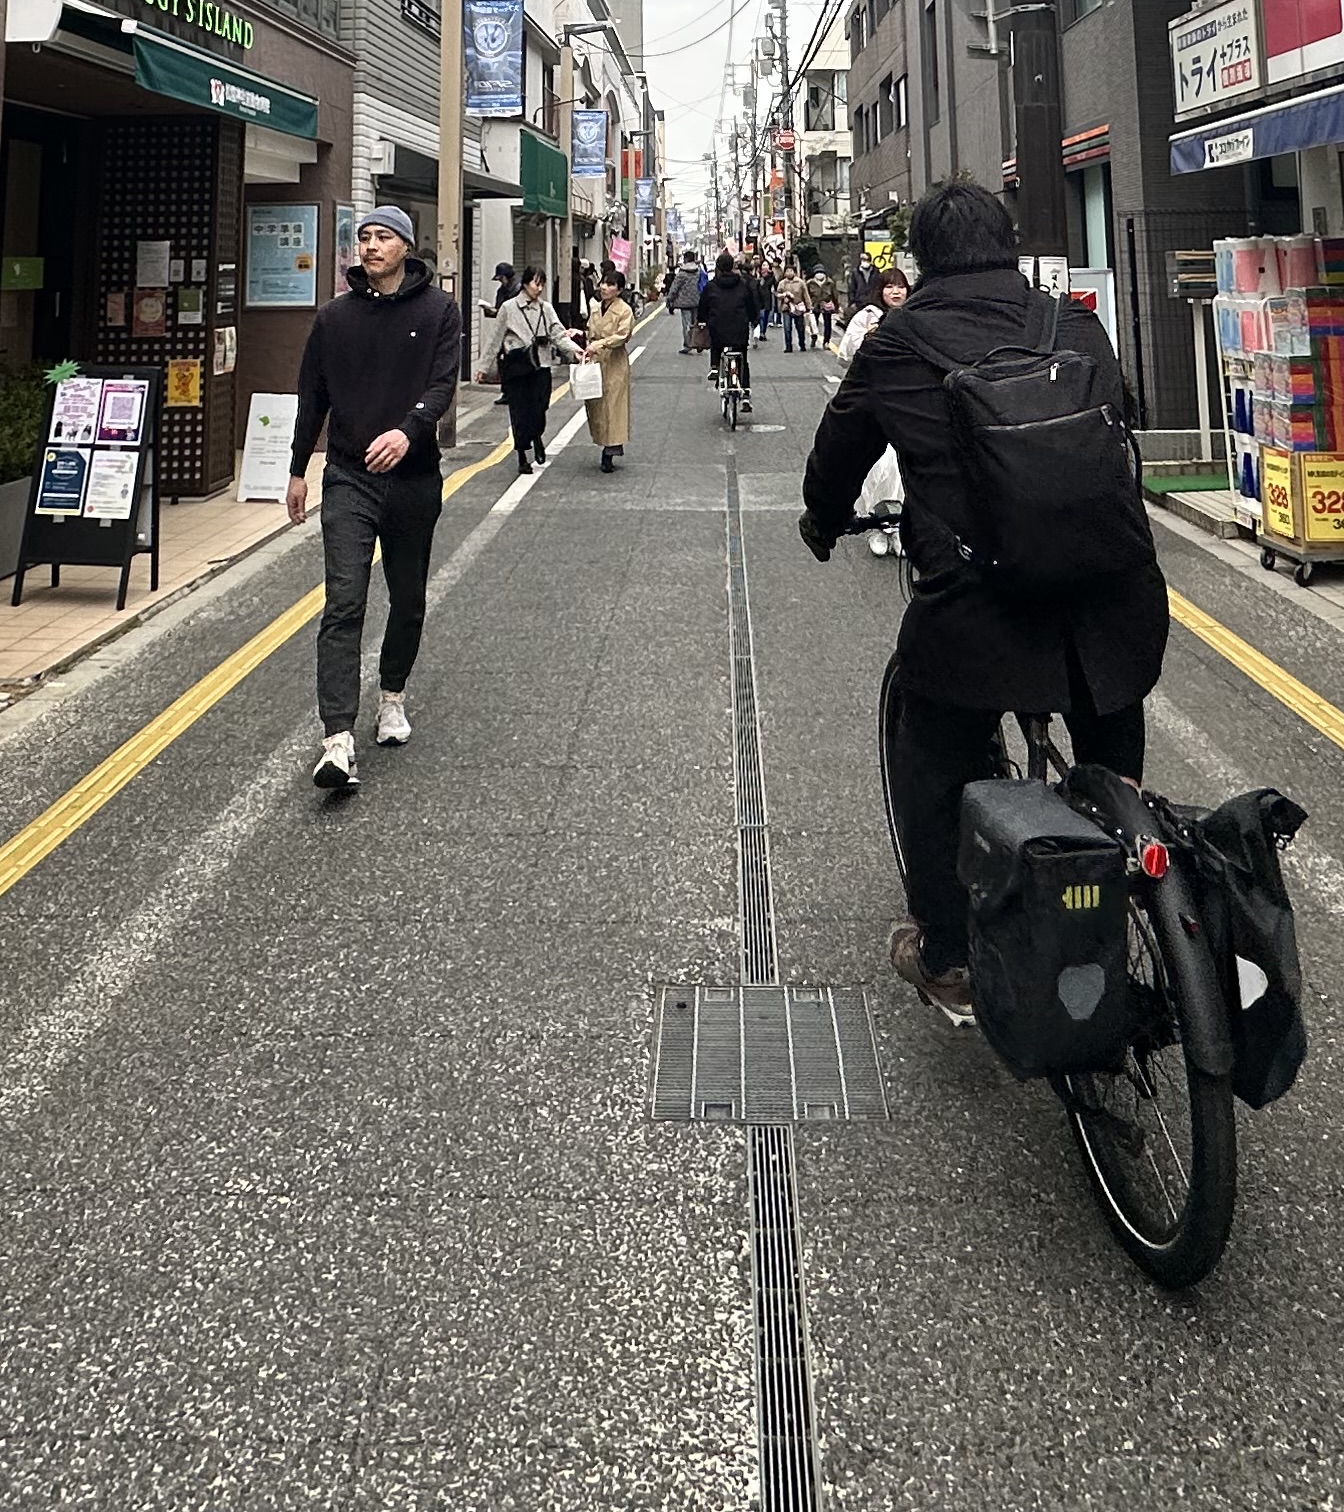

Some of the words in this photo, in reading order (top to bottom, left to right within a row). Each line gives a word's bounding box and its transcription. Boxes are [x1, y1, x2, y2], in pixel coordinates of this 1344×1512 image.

[1179, 46, 1218, 102] トライ
[1268, 482, 1289, 510] 328
